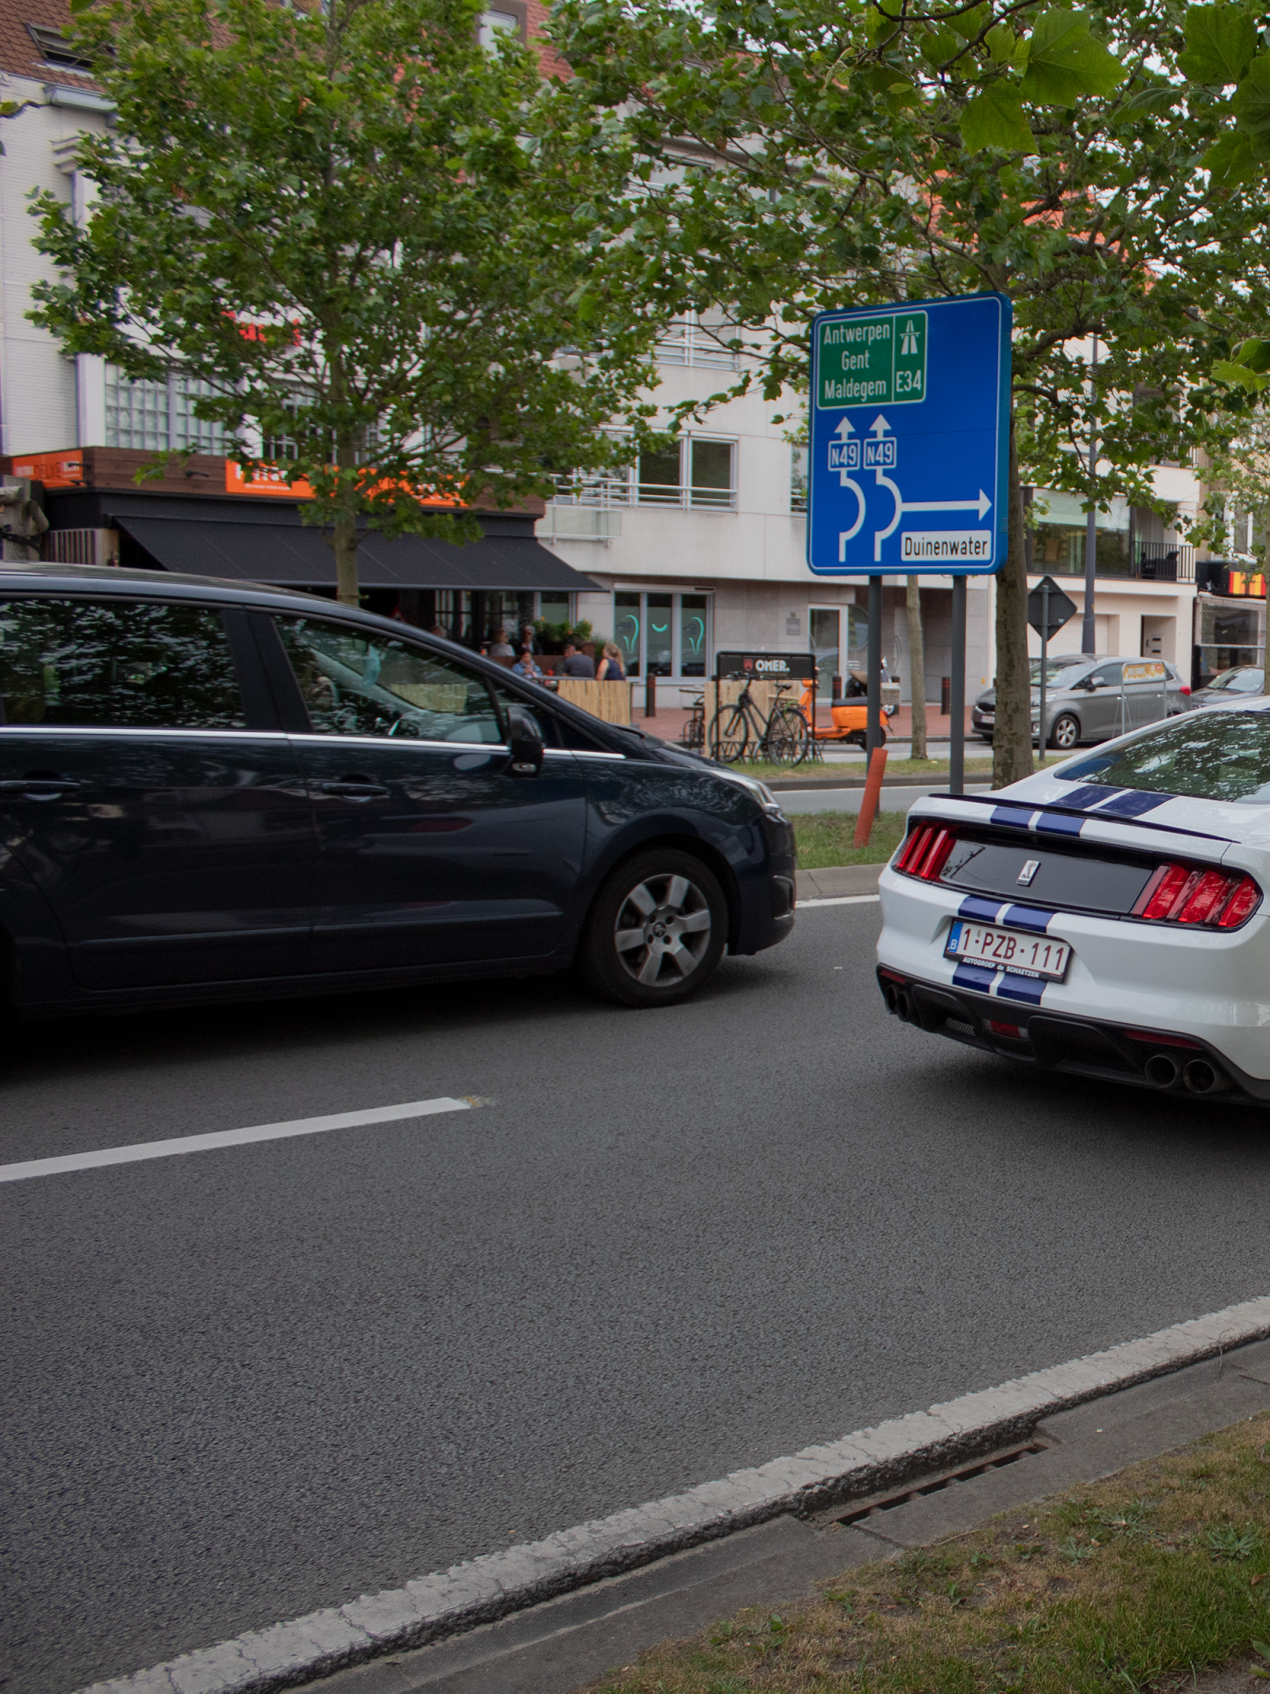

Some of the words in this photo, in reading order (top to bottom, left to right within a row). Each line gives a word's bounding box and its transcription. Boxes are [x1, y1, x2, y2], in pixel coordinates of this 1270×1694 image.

[823, 323, 891, 346] Antwerpen
[841, 349, 870, 371] Gent
[824, 378, 887, 402] Maldegem
[896, 370, 922, 392] E34
[831, 444, 857, 466] N49
[866, 442, 893, 464] N49
[905, 537, 988, 557] Duinenwater
[755, 659, 790, 672] OMER.
[949, 939, 958, 950] B
[962, 956, 995, 969] AUTOGROEP
[1006, 965, 1040, 979] SCHAETZEN
